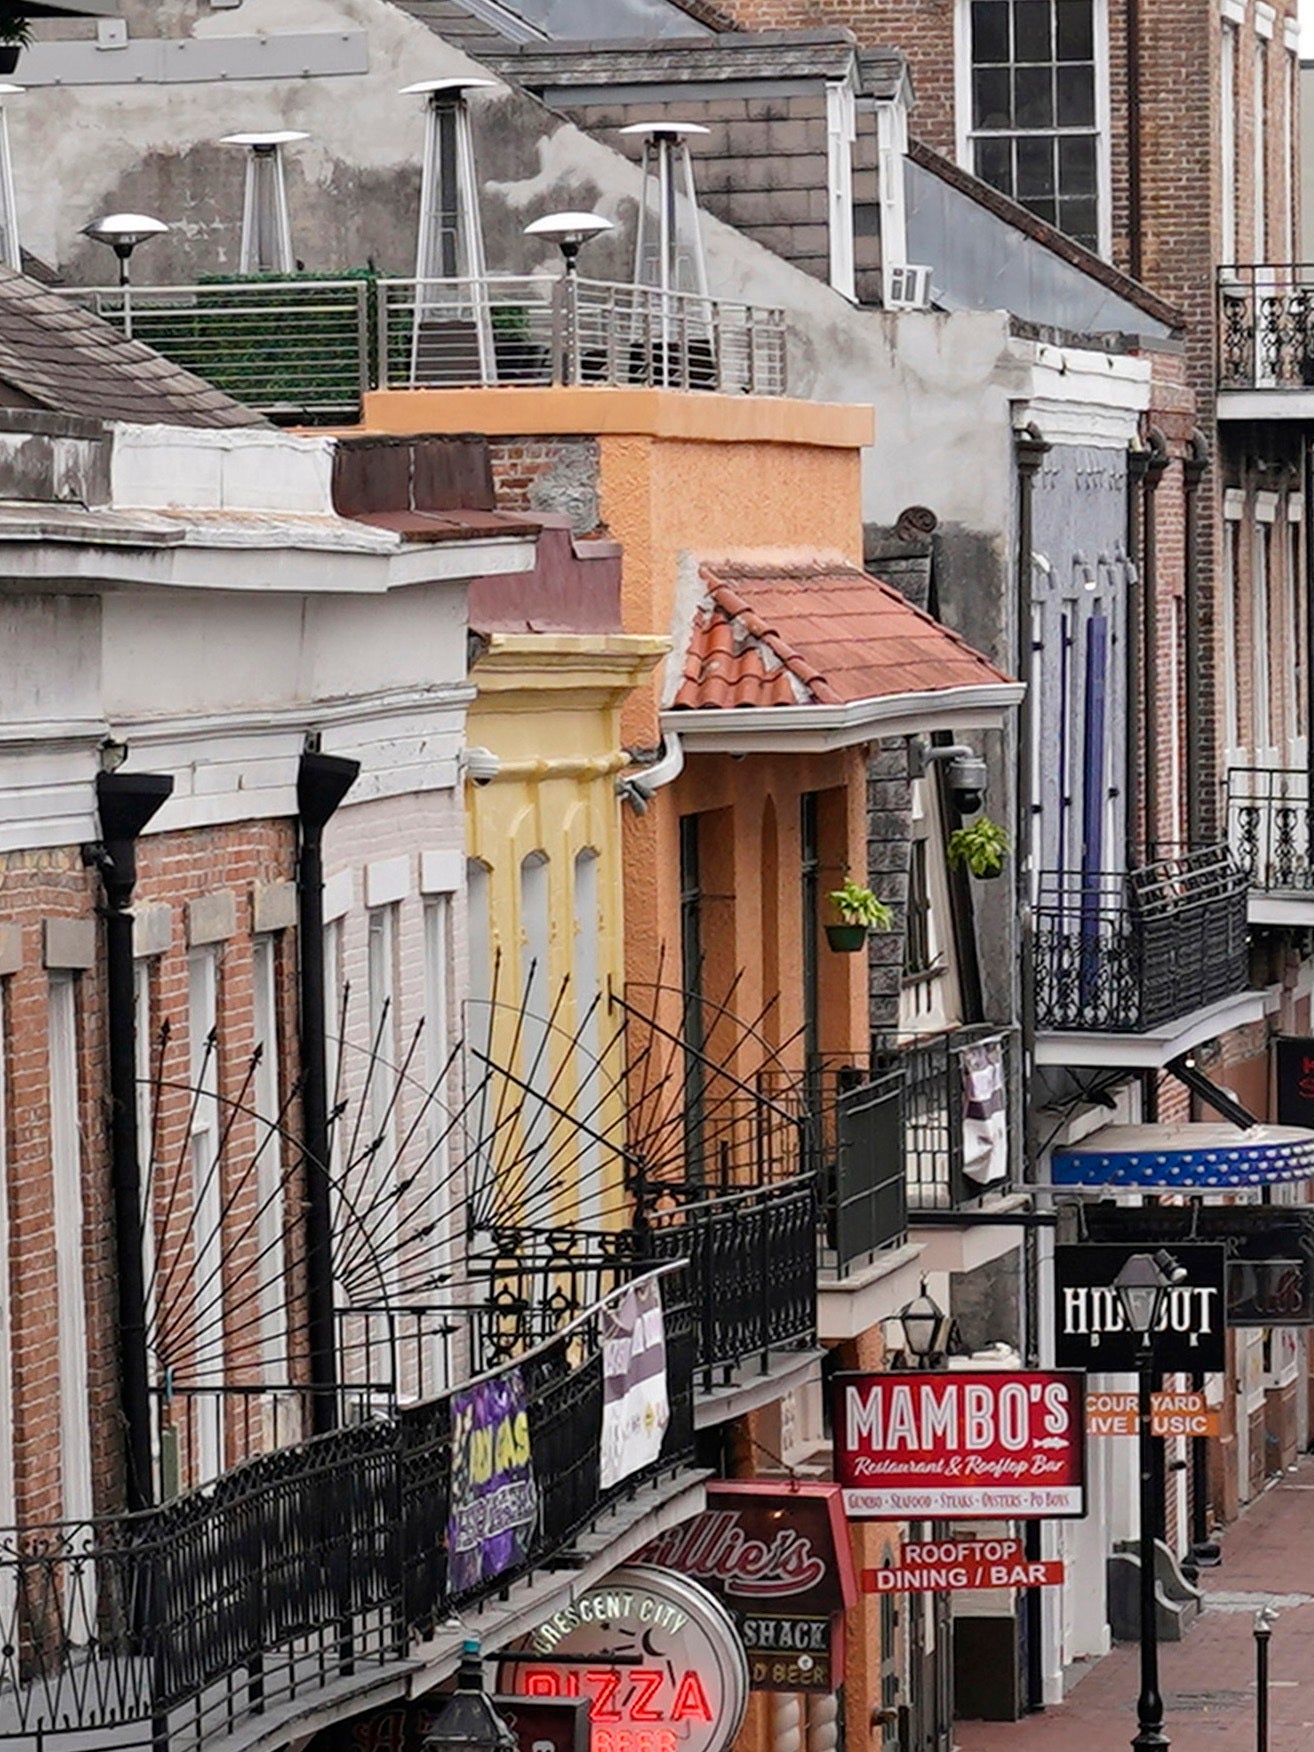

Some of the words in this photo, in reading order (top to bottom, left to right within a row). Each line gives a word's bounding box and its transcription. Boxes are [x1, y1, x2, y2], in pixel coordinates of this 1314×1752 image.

[1063, 1287, 1218, 1333] HIDUT
[846, 1383, 1070, 1450] MAMBO'S
[1086, 1396, 1201, 1412] COURYARD
[1086, 1416, 1127, 1433] IVE
[854, 1456, 944, 1476] Restaurant
[944, 1457, 962, 1476] &
[964, 1454, 1029, 1478] Rooftop
[1030, 1453, 1065, 1473] Bar
[630, 1511, 815, 1585] illie's
[905, 1541, 1017, 1564] ROOFTOP
[877, 1567, 967, 1589] DINING
[990, 1564, 1047, 1585] BAR
[534, 1594, 634, 1657] CRESCENT
[639, 1600, 688, 1635] CITY
[743, 1620, 827, 1649] SHACK
[773, 1662, 824, 1684] BEER
